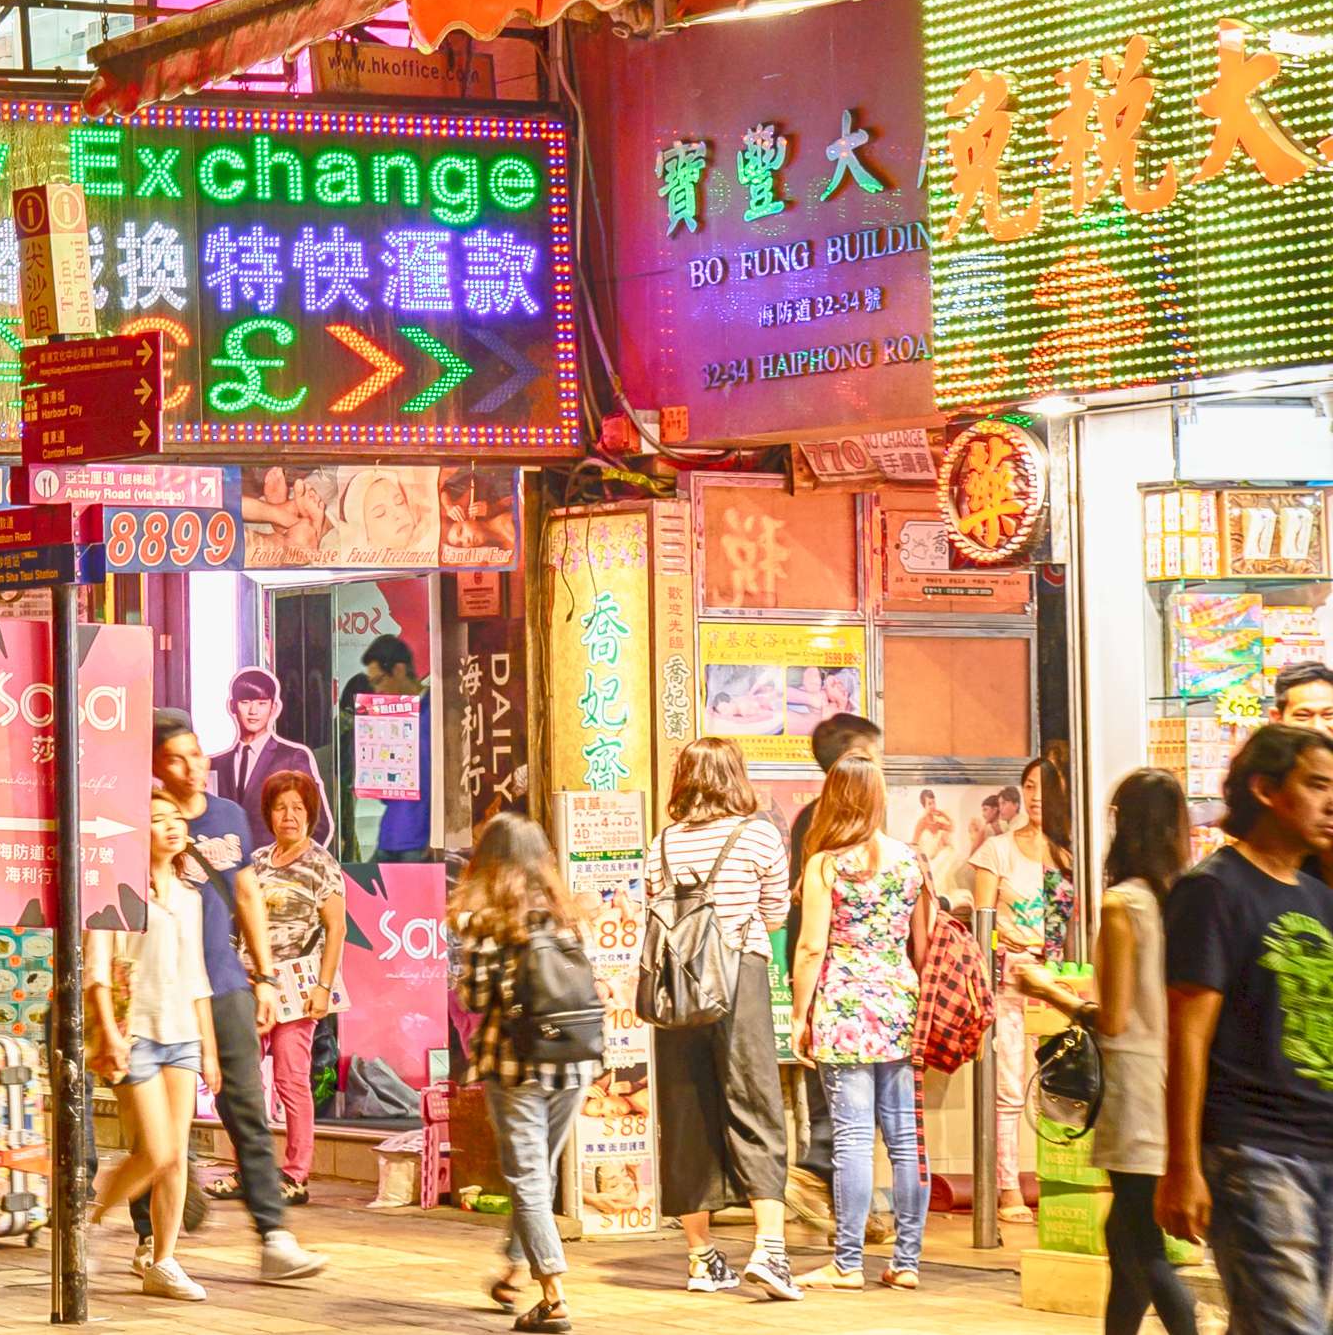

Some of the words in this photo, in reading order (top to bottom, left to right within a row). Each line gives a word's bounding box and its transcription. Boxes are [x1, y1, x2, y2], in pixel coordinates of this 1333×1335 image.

[69, 127, 538, 225] Exchange
[25, 238, 54, 334] 尖沙咀
[60, 258, 74, 314] Tsim
[77, 239, 90, 285] Tsui
[689, 256, 725, 290] BO
[739, 239, 811, 282] FUNG
[77, 289, 91, 330] Sha
[757, 341, 874, 382] HAIPHONG
[64, 487, 101, 503] Ashley
[103, 487, 131, 501] Road
[105, 510, 237, 567] 8899
[346, 546, 381, 563] Facial
[381, 547, 436, 564] Treatment
[457, 654, 486, 797] 海利行
[491, 652, 514, 805] DAILY
